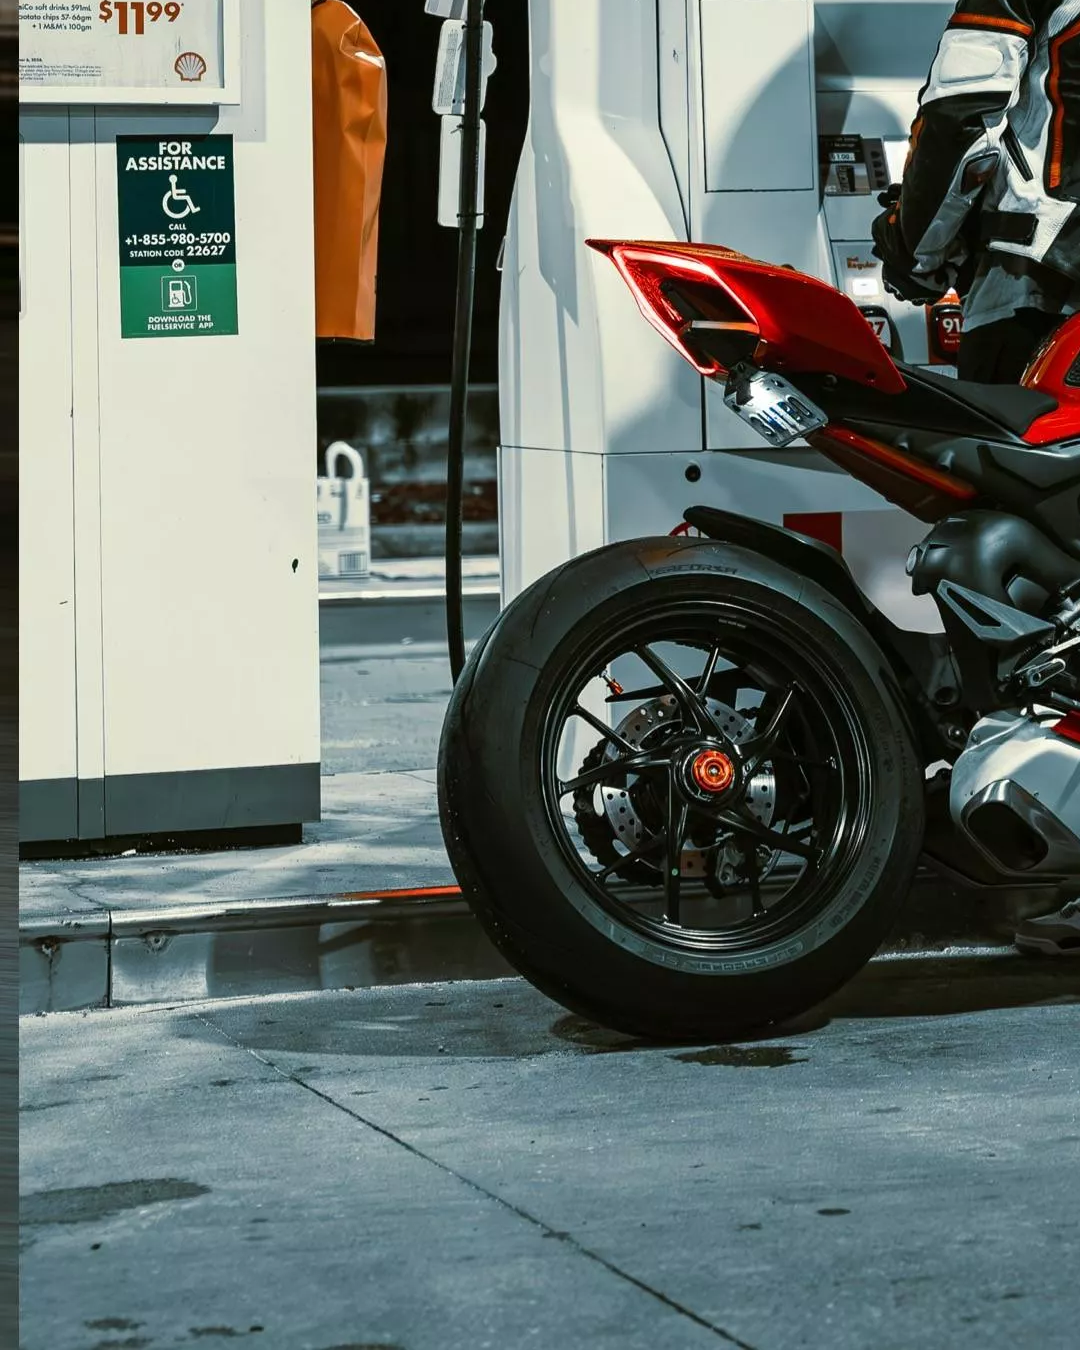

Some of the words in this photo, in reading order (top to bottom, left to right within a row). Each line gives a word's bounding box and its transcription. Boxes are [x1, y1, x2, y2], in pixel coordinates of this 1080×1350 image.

[49, 3, 69, 11] drinks
[42, 13, 60, 21] chips
[69, 24, 92, 32] 100gm
[158, 141, 192, 155] FOR
[125, 156, 226, 171] ASSISTANCE
[125, 232, 231, 246] +1-855-980-5700
[129, 250, 162, 258] STATION
[163, 249, 185, 257] CODE
[186, 245, 226, 256] 22627
[148, 315, 195, 324] DOWNLOAD
[197, 314, 212, 322] THE
[147, 322, 194, 331] FUELSERVICE
[198, 321, 213, 329] APP
[943, 318, 961, 334] 91
